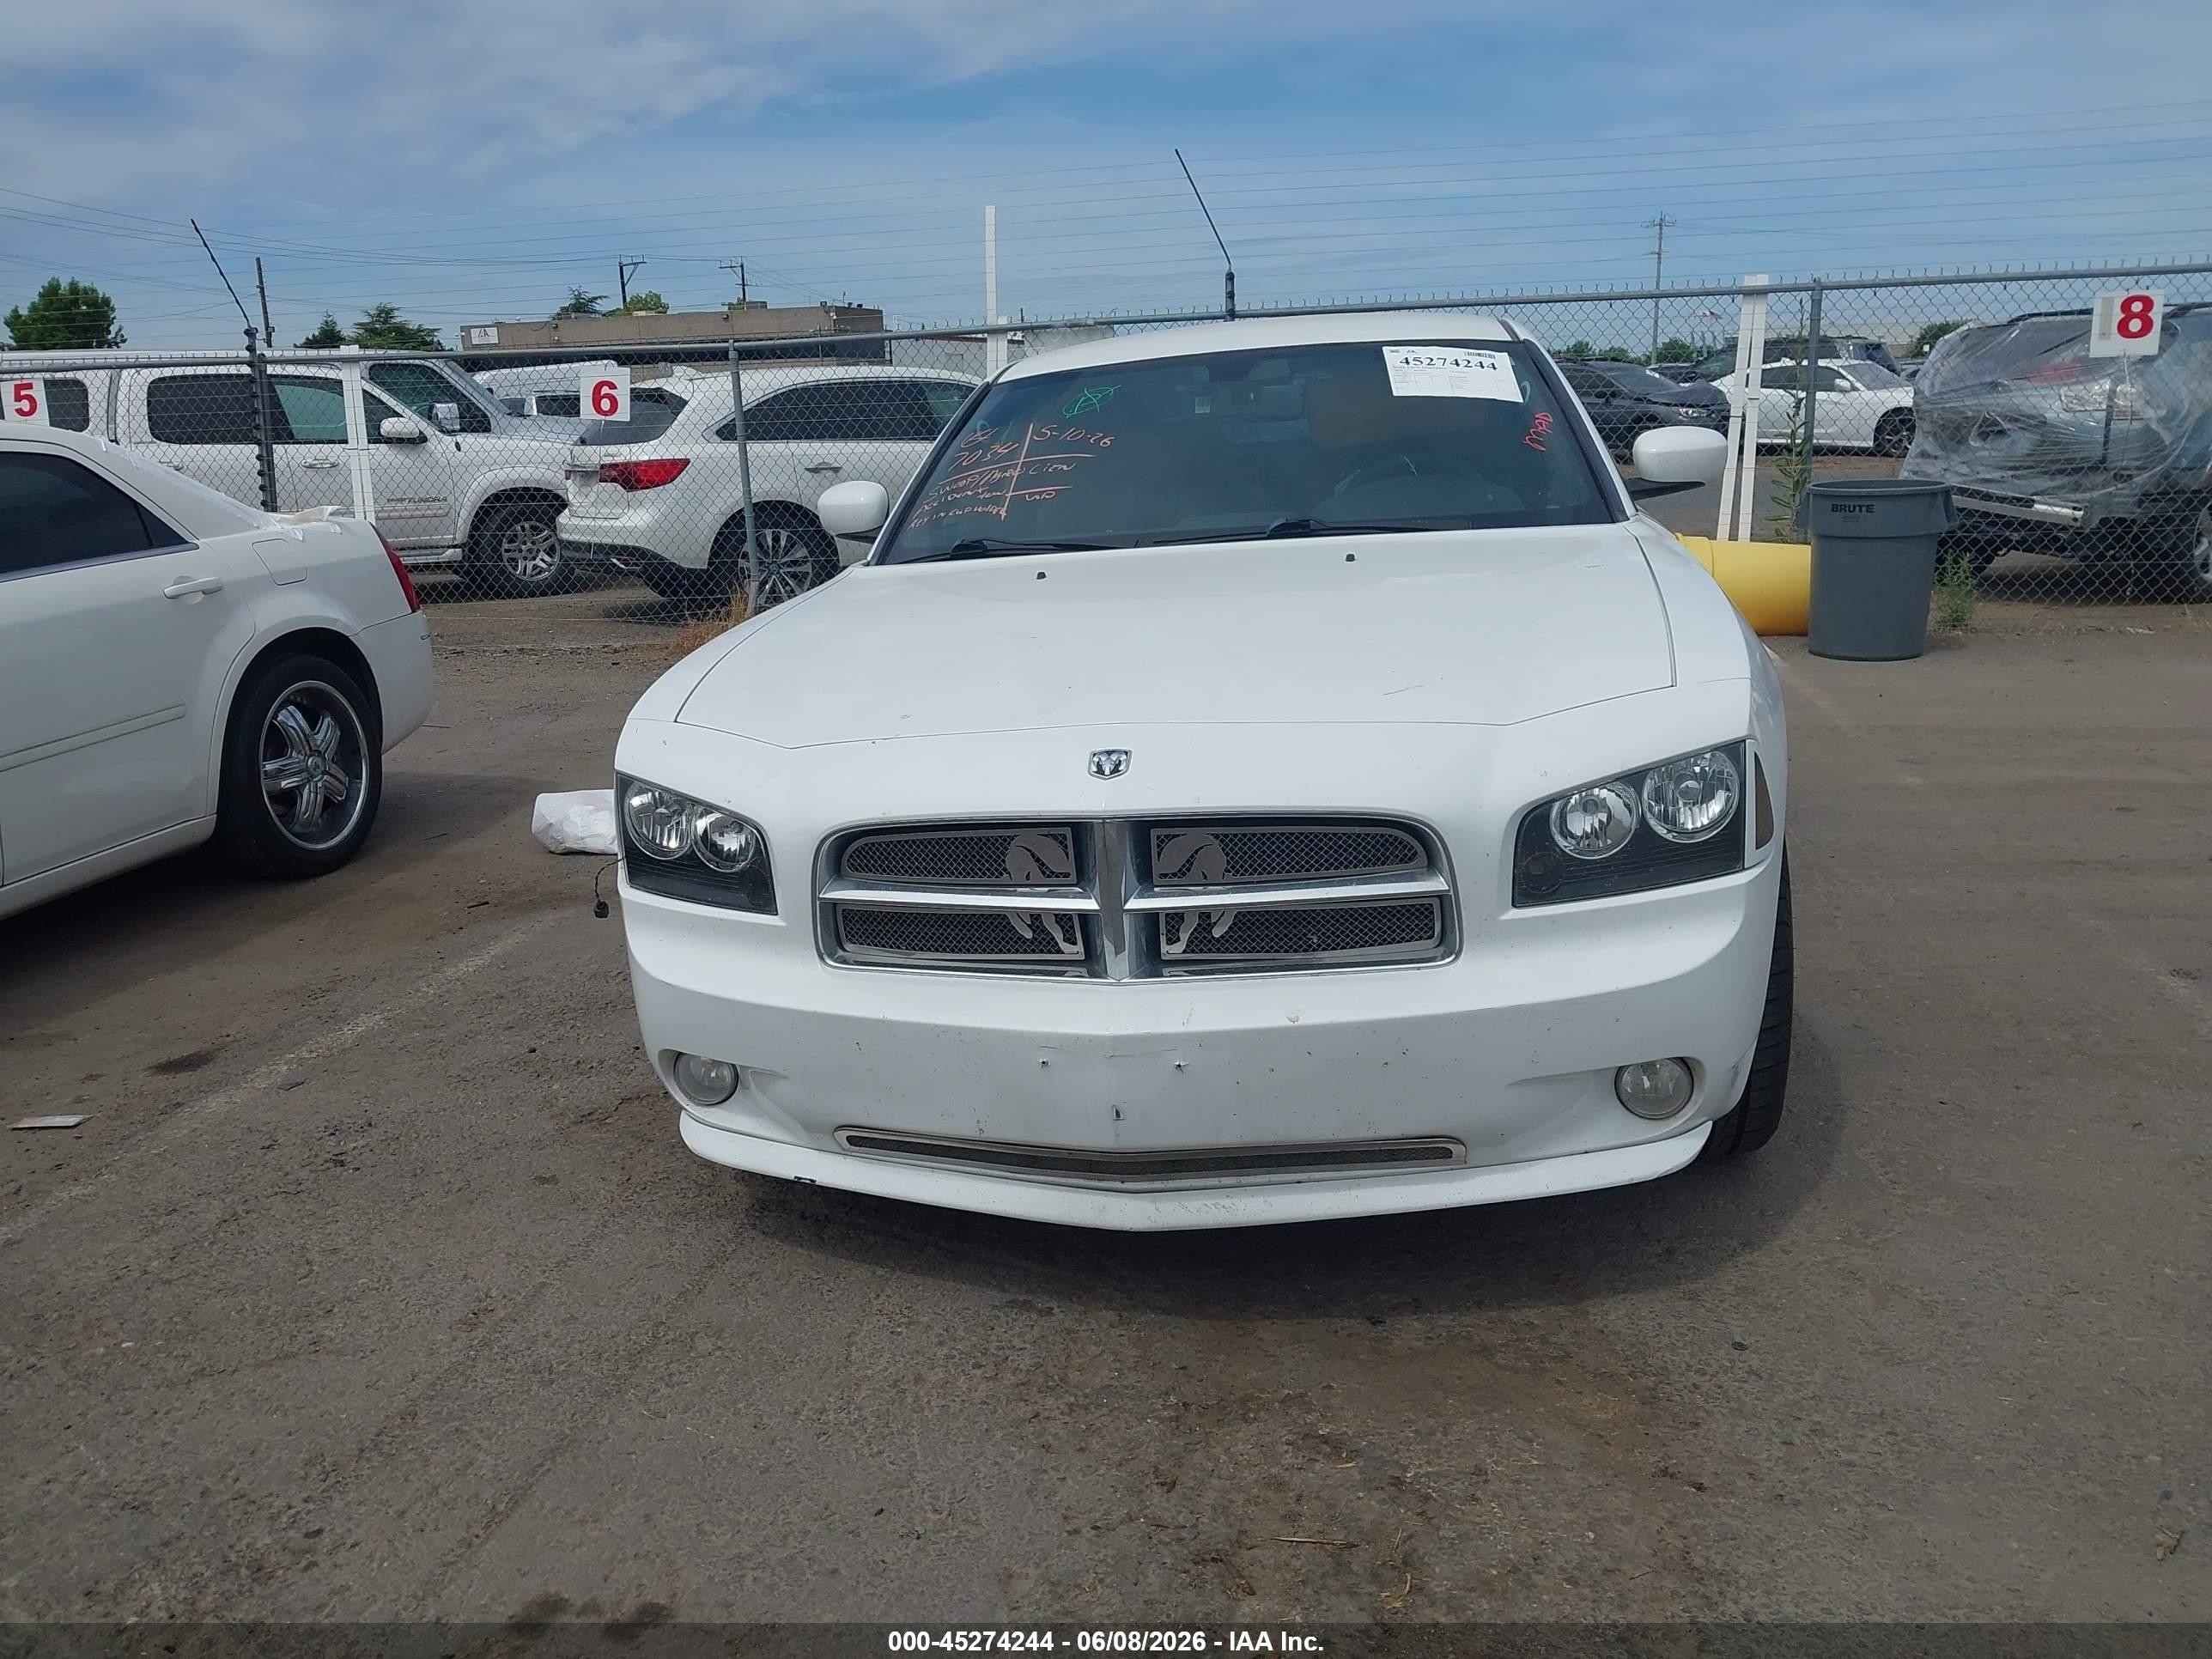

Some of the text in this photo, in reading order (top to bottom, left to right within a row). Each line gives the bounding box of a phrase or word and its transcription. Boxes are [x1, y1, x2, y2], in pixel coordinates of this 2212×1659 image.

[2117, 294, 2154, 339] 8
[1399, 356, 1498, 371] 45274244
[14, 382, 38, 417] 5
[592, 380, 618, 416] 6
[1831, 503, 1875, 514] BRUTE
